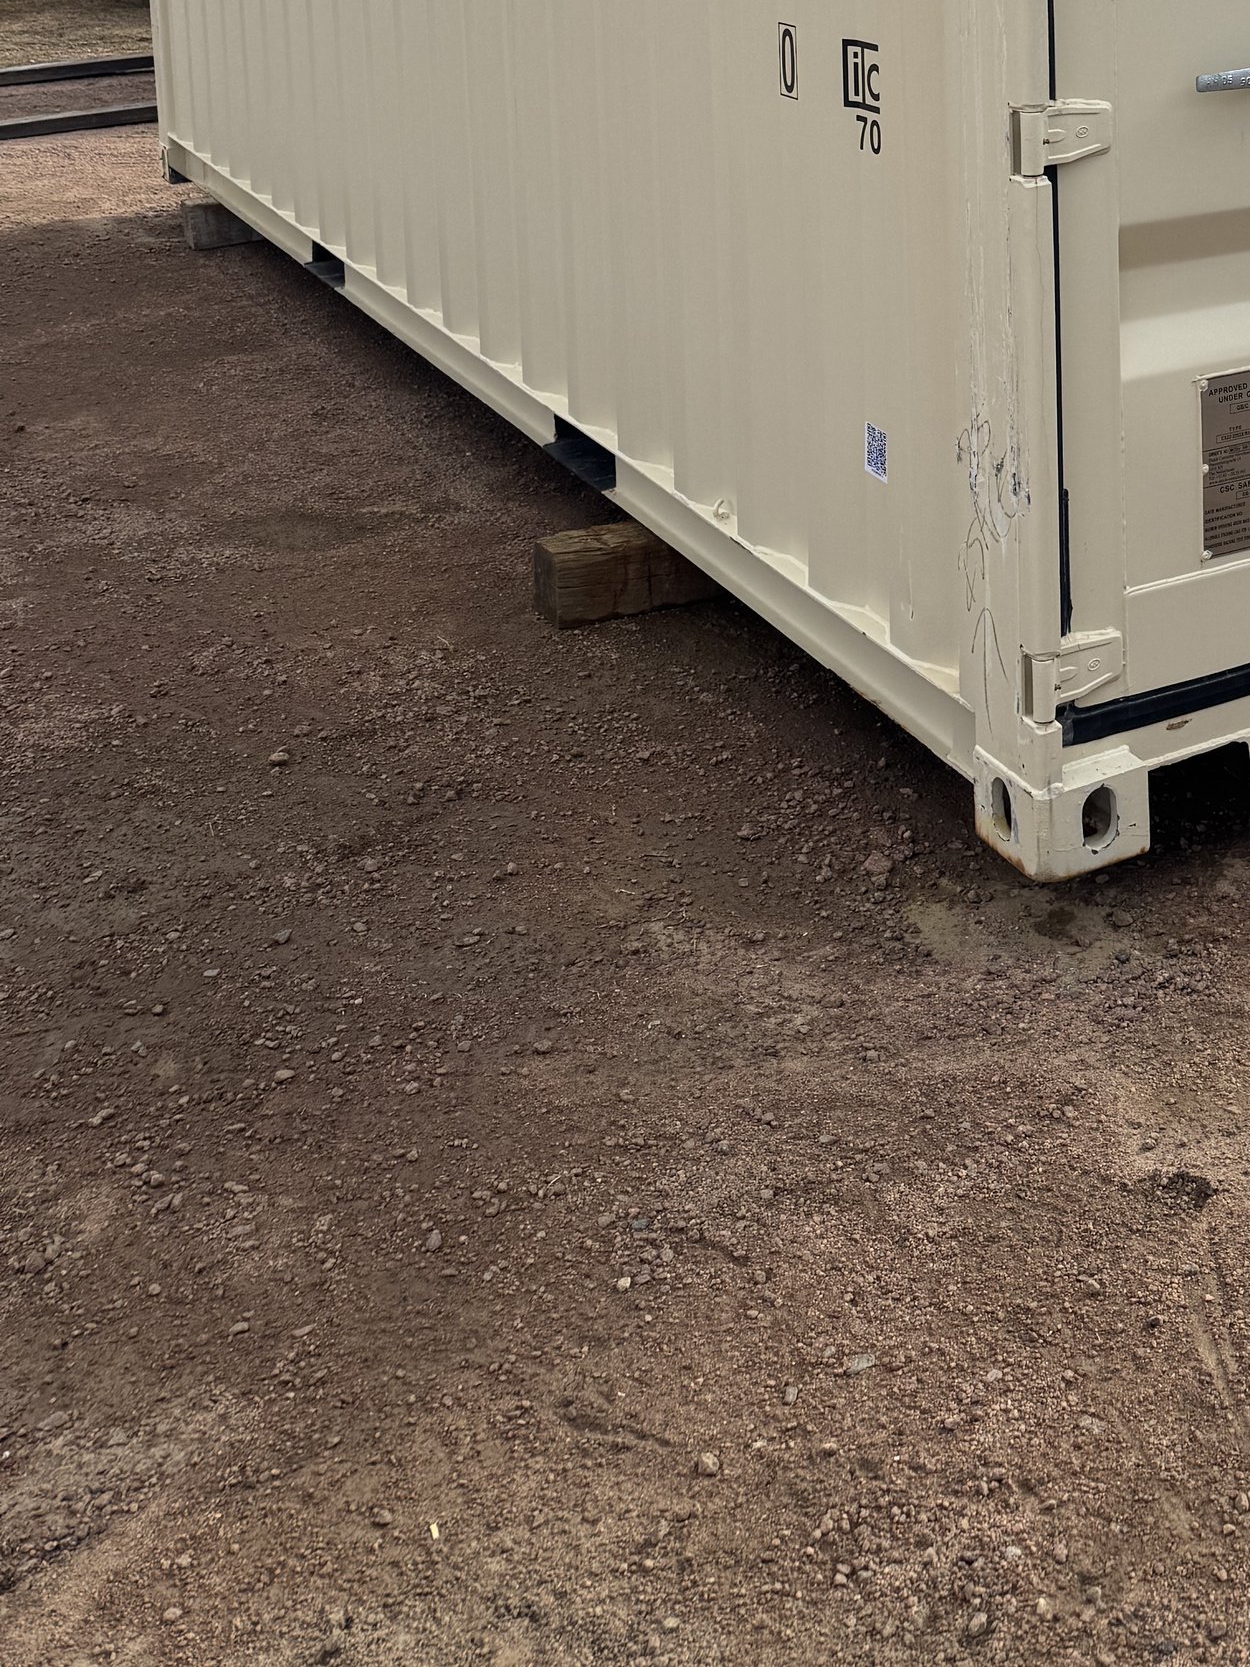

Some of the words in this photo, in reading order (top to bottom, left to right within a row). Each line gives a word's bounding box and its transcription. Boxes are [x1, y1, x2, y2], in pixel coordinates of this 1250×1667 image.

[780, 27, 796, 95] 0
[856, 113, 882, 156] 70
[1208, 382, 1248, 396] APPROVED
[1218, 393, 1244, 403] UNDER
[1219, 485, 1235, 494] CSC
